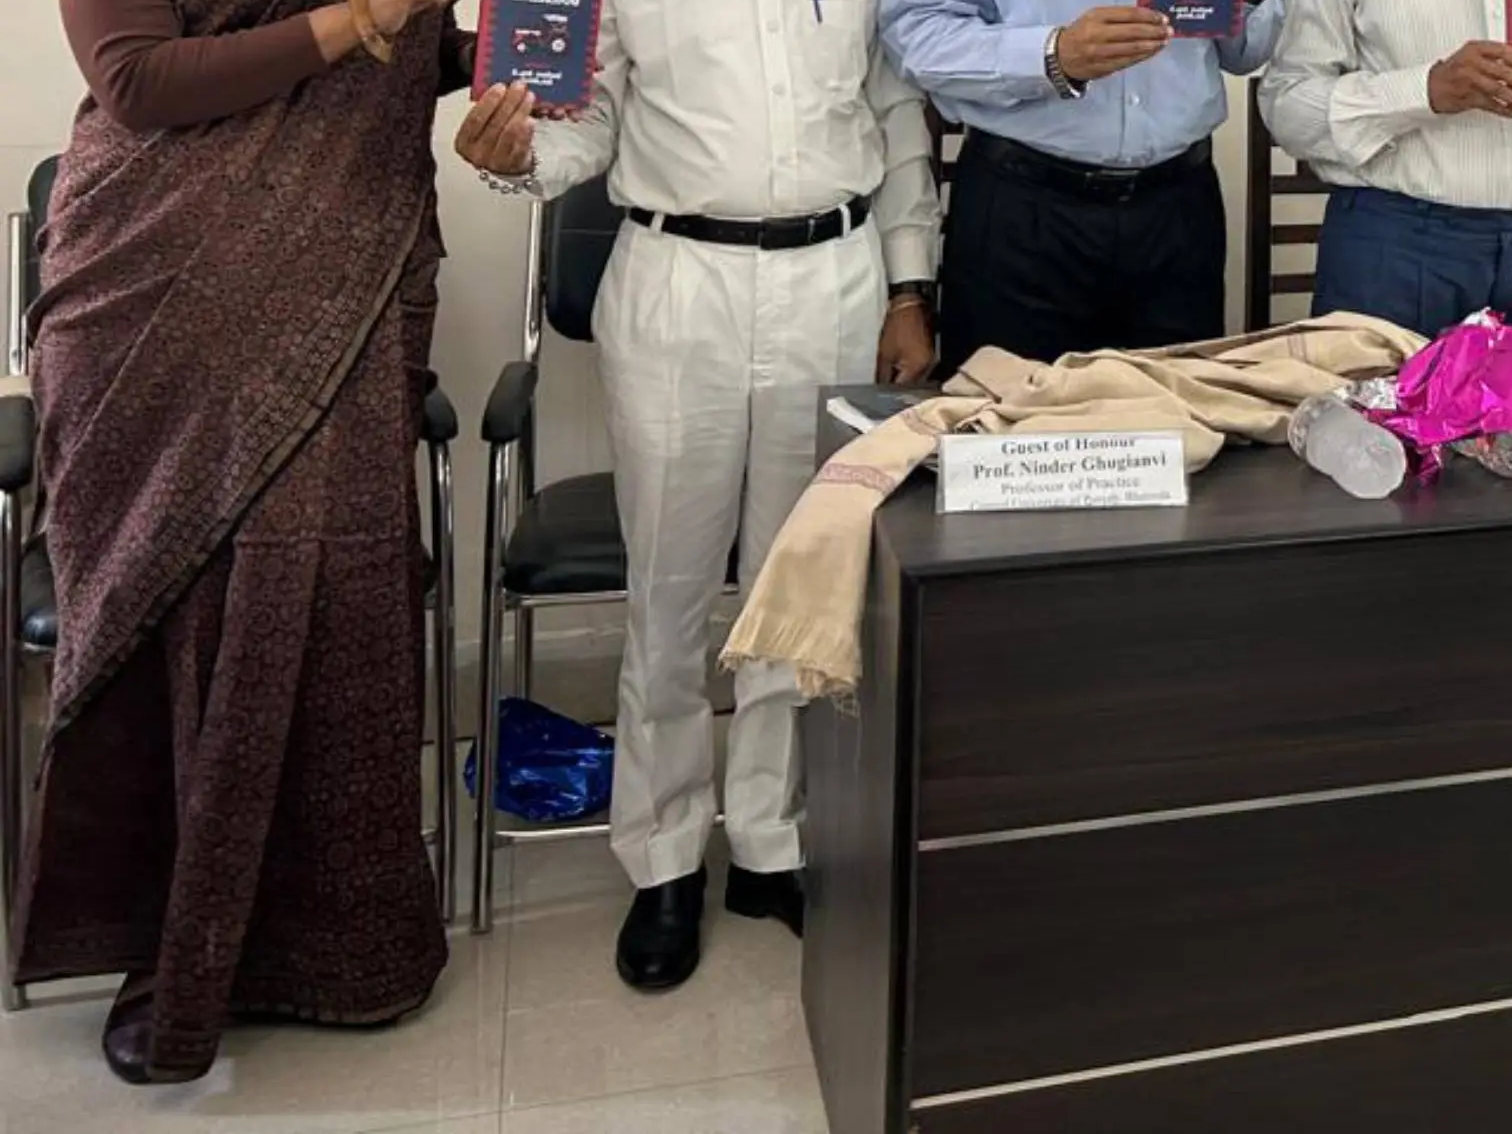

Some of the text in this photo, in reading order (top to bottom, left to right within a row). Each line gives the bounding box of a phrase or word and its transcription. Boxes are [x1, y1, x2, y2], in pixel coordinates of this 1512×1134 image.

[1001, 436, 1136, 455] Guest of Honour
[973, 462, 1014, 480] Prof.
[1020, 458, 1077, 478] Ninder
[1001, 479, 1065, 495] Professor
[1068, 477, 1083, 492] of
